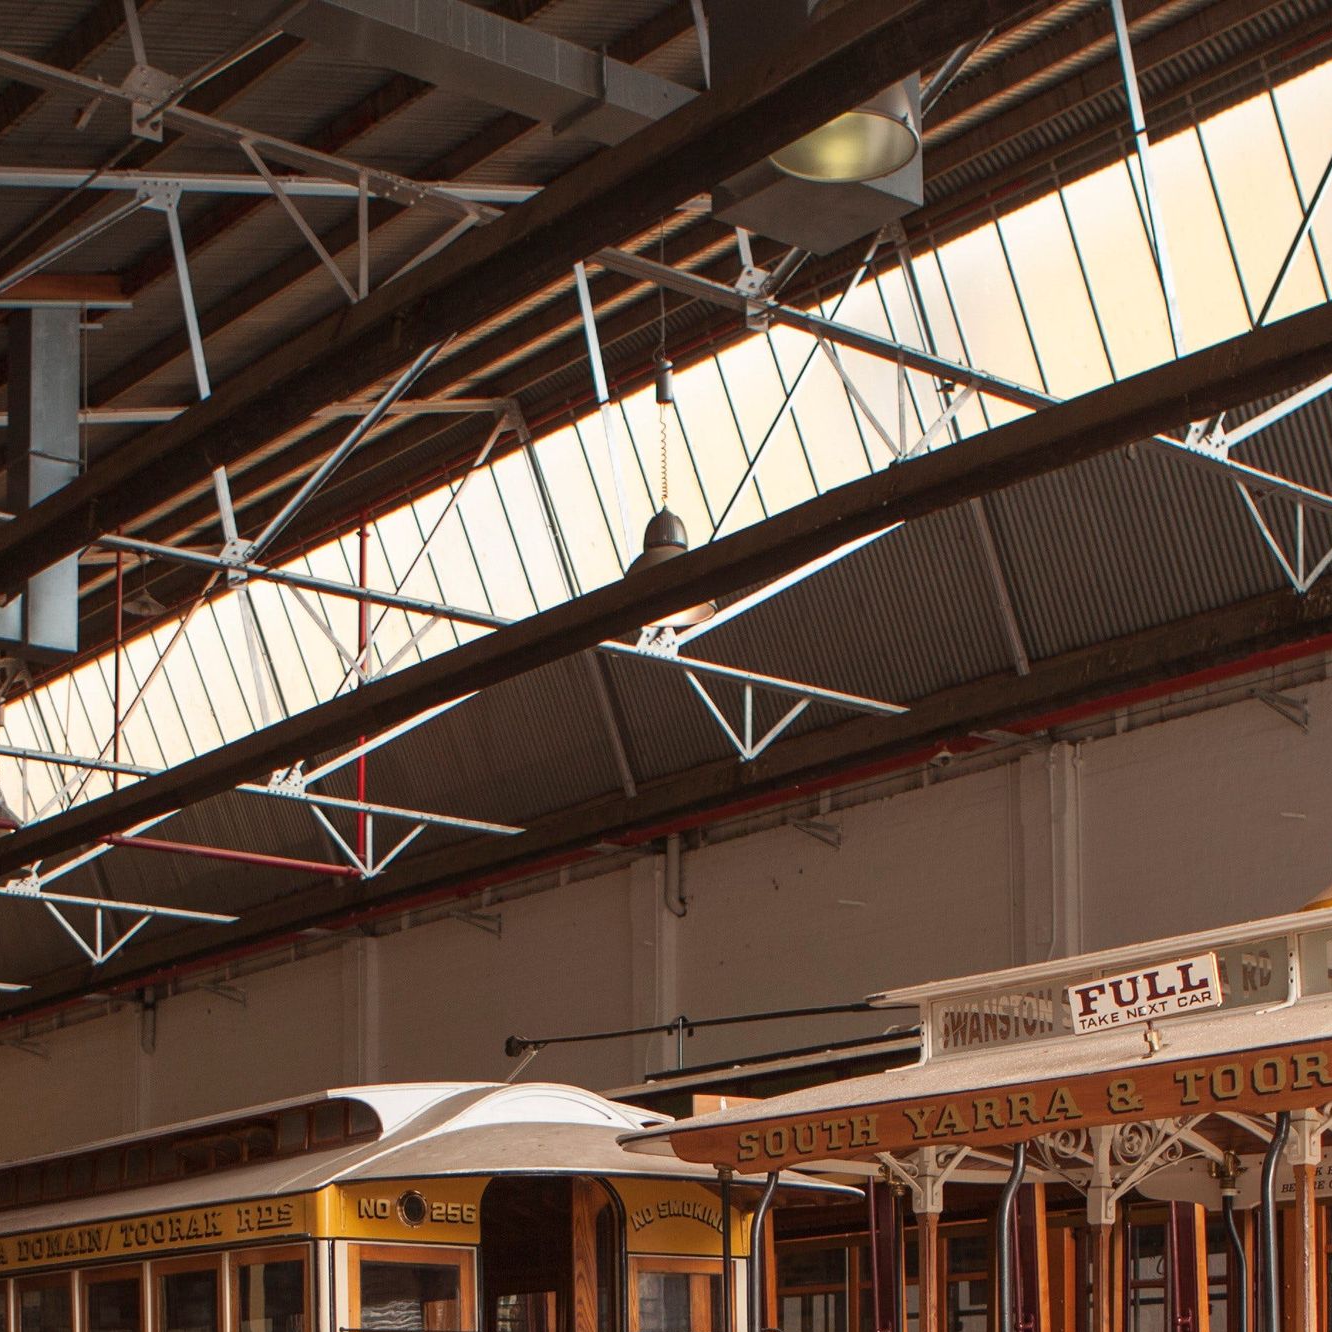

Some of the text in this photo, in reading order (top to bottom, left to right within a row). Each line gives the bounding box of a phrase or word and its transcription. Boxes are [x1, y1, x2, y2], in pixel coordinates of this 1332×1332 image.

[1075, 962, 1209, 1017] FULL
[1079, 990, 1212, 1030] TAKE NEXT CAR
[738, 1113, 879, 1161] SOUTH
[903, 1086, 1082, 1140] YARRA
[1106, 1078, 1144, 1116] &
[119, 1211, 223, 1248] TOORAK
[358, 1198, 477, 1224] NO 256
[630, 1206, 654, 1232] NO
